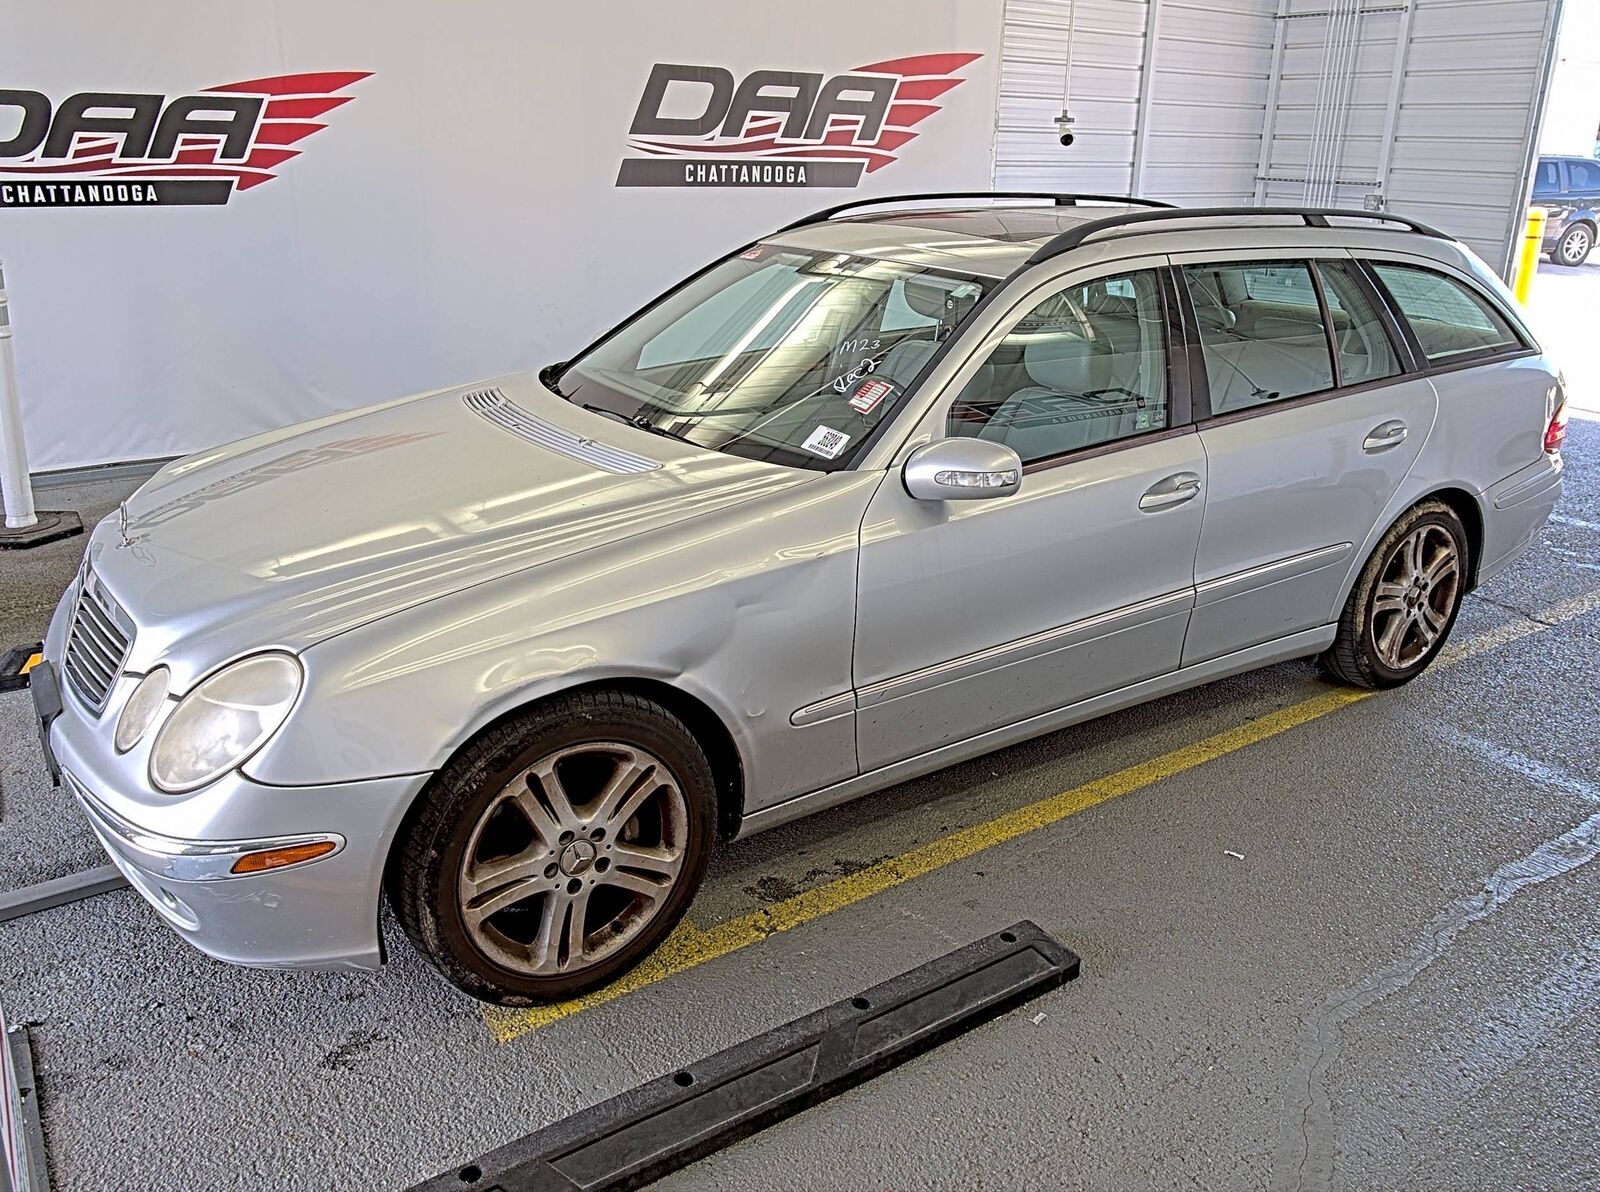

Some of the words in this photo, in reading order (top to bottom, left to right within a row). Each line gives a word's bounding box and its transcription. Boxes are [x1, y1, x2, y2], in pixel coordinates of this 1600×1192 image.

[628, 63, 898, 141] DAA
[684, 163, 808, 185] CHATTANOOGA
[2, 183, 159, 204] CHATTANOOGA
[839, 339, 881, 355] M23
